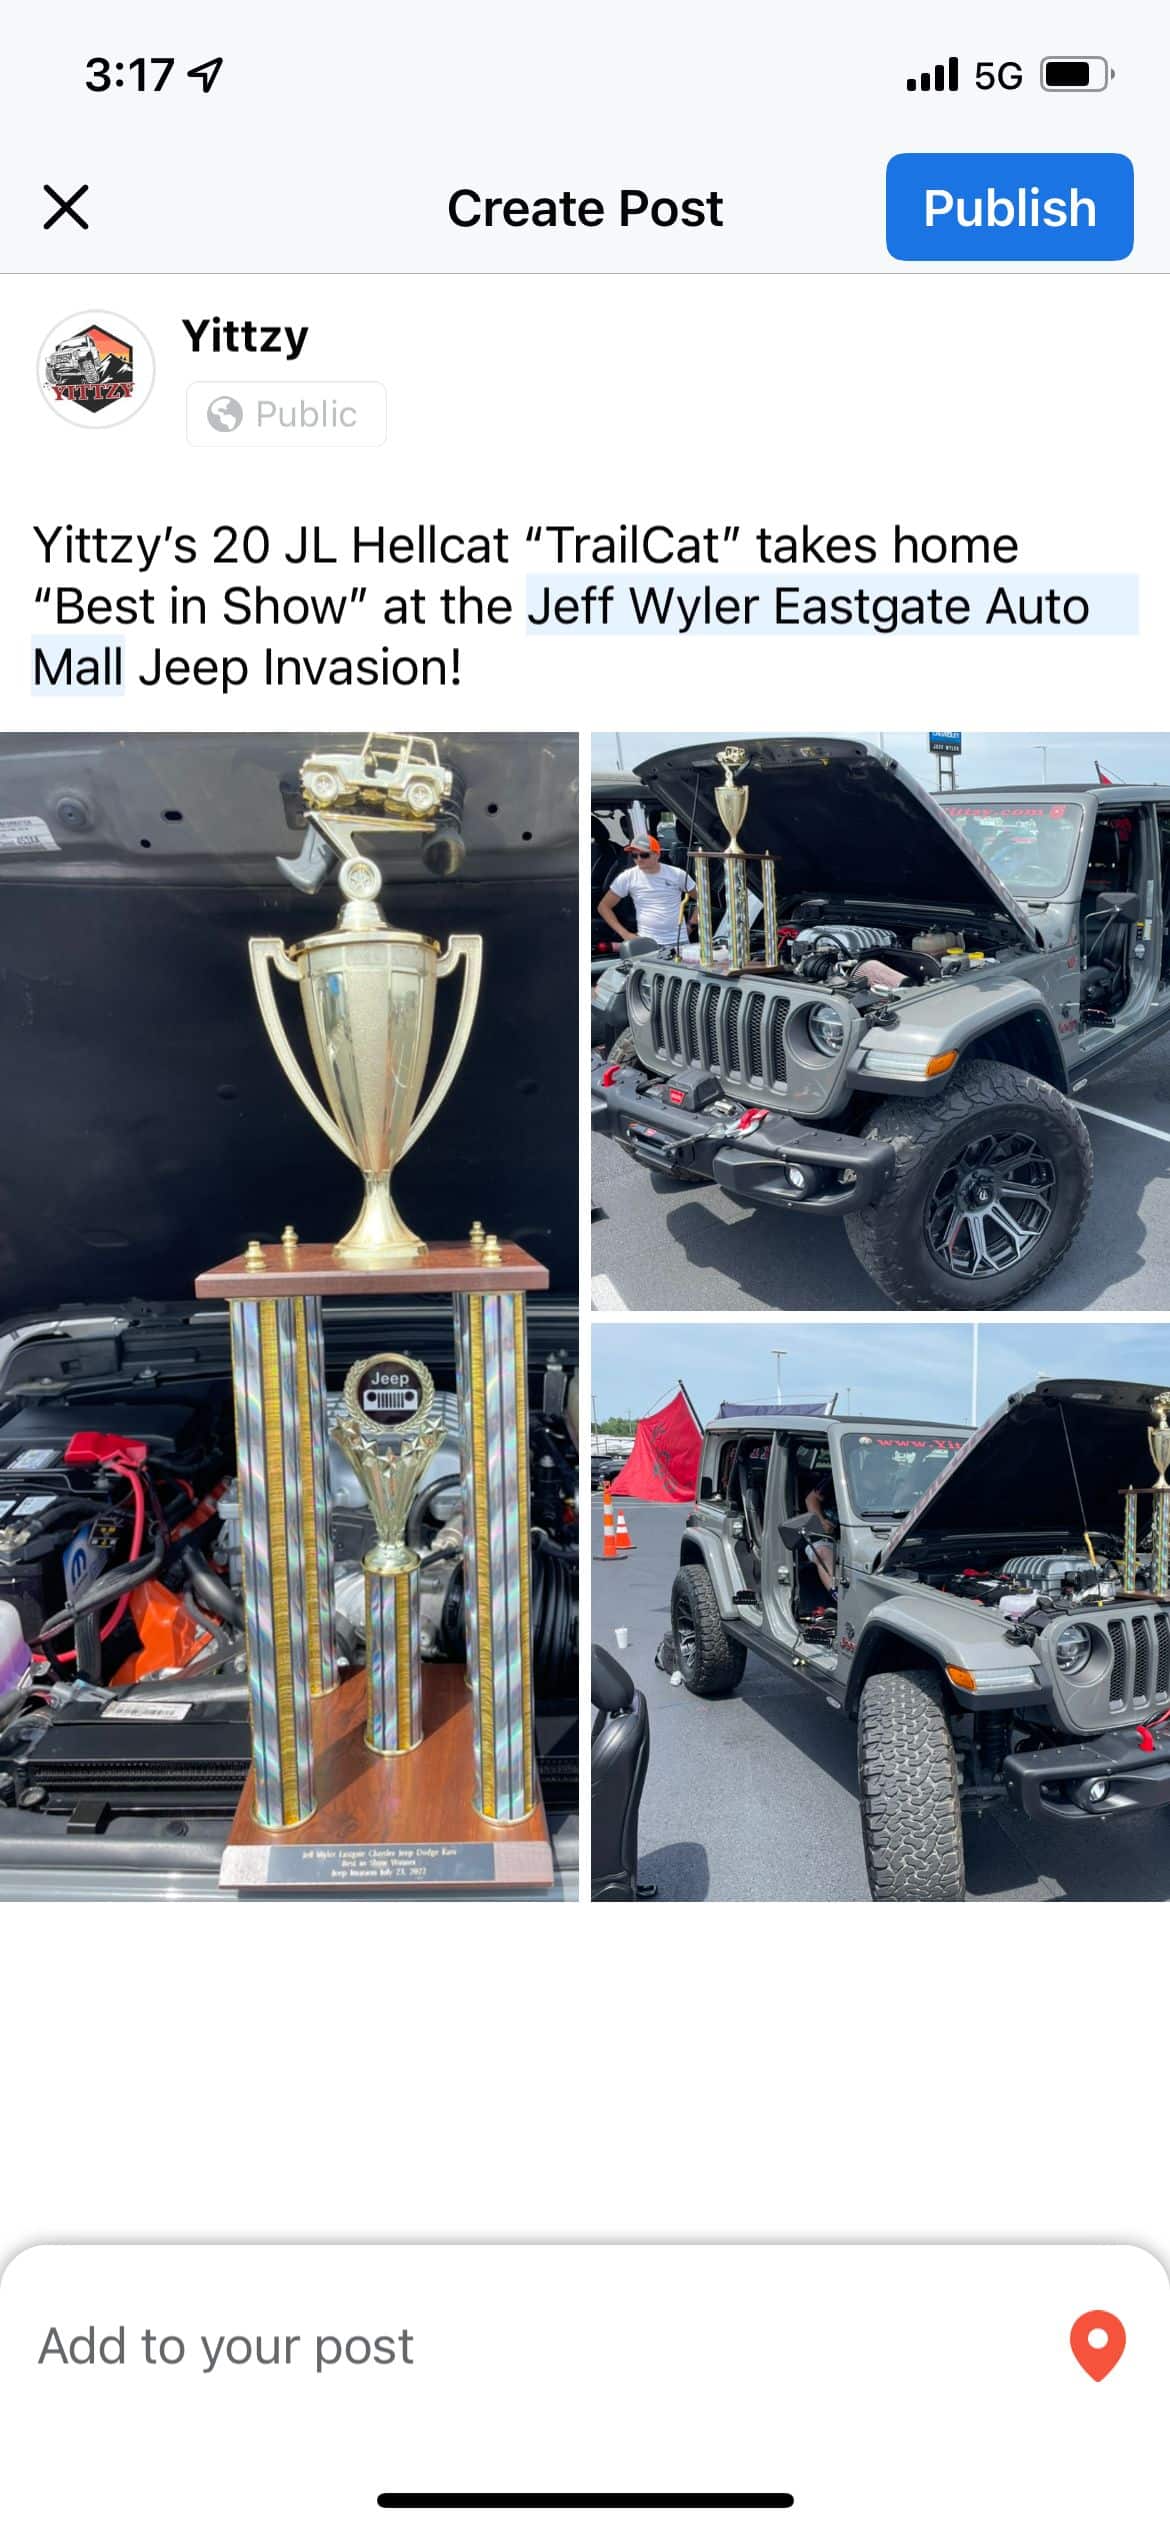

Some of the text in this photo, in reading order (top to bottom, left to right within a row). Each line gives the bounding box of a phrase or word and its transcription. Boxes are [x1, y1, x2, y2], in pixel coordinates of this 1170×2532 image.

[86, 57, 174, 92] 3:17
[975, 62, 1023, 91] 5G
[449, 188, 724, 228] Create Post
[926, 187, 1096, 228] Publish
[182, 316, 309, 361] Yittzy
[51, 382, 135, 401] YITTZY
[257, 399, 357, 428] Public
[214, 525, 270, 564] 20
[285, 526, 338, 564] JL
[353, 524, 509, 564] Hellcat
[756, 524, 877, 564] takes
[894, 524, 1019, 564] home
[170, 585, 206, 624] in
[383, 589, 426, 625] at
[440, 585, 513, 625] the
[528, 585, 614, 625] Jeff
[628, 585, 760, 634] Wyler
[775, 587, 971, 634] Eastgate
[986, 587, 1090, 625] Auto
[35, 646, 461, 696] Mall Jeep Invasion!
[371, 1371, 409, 1387] Jeep
[38, 2325, 414, 2374] Add to your post
